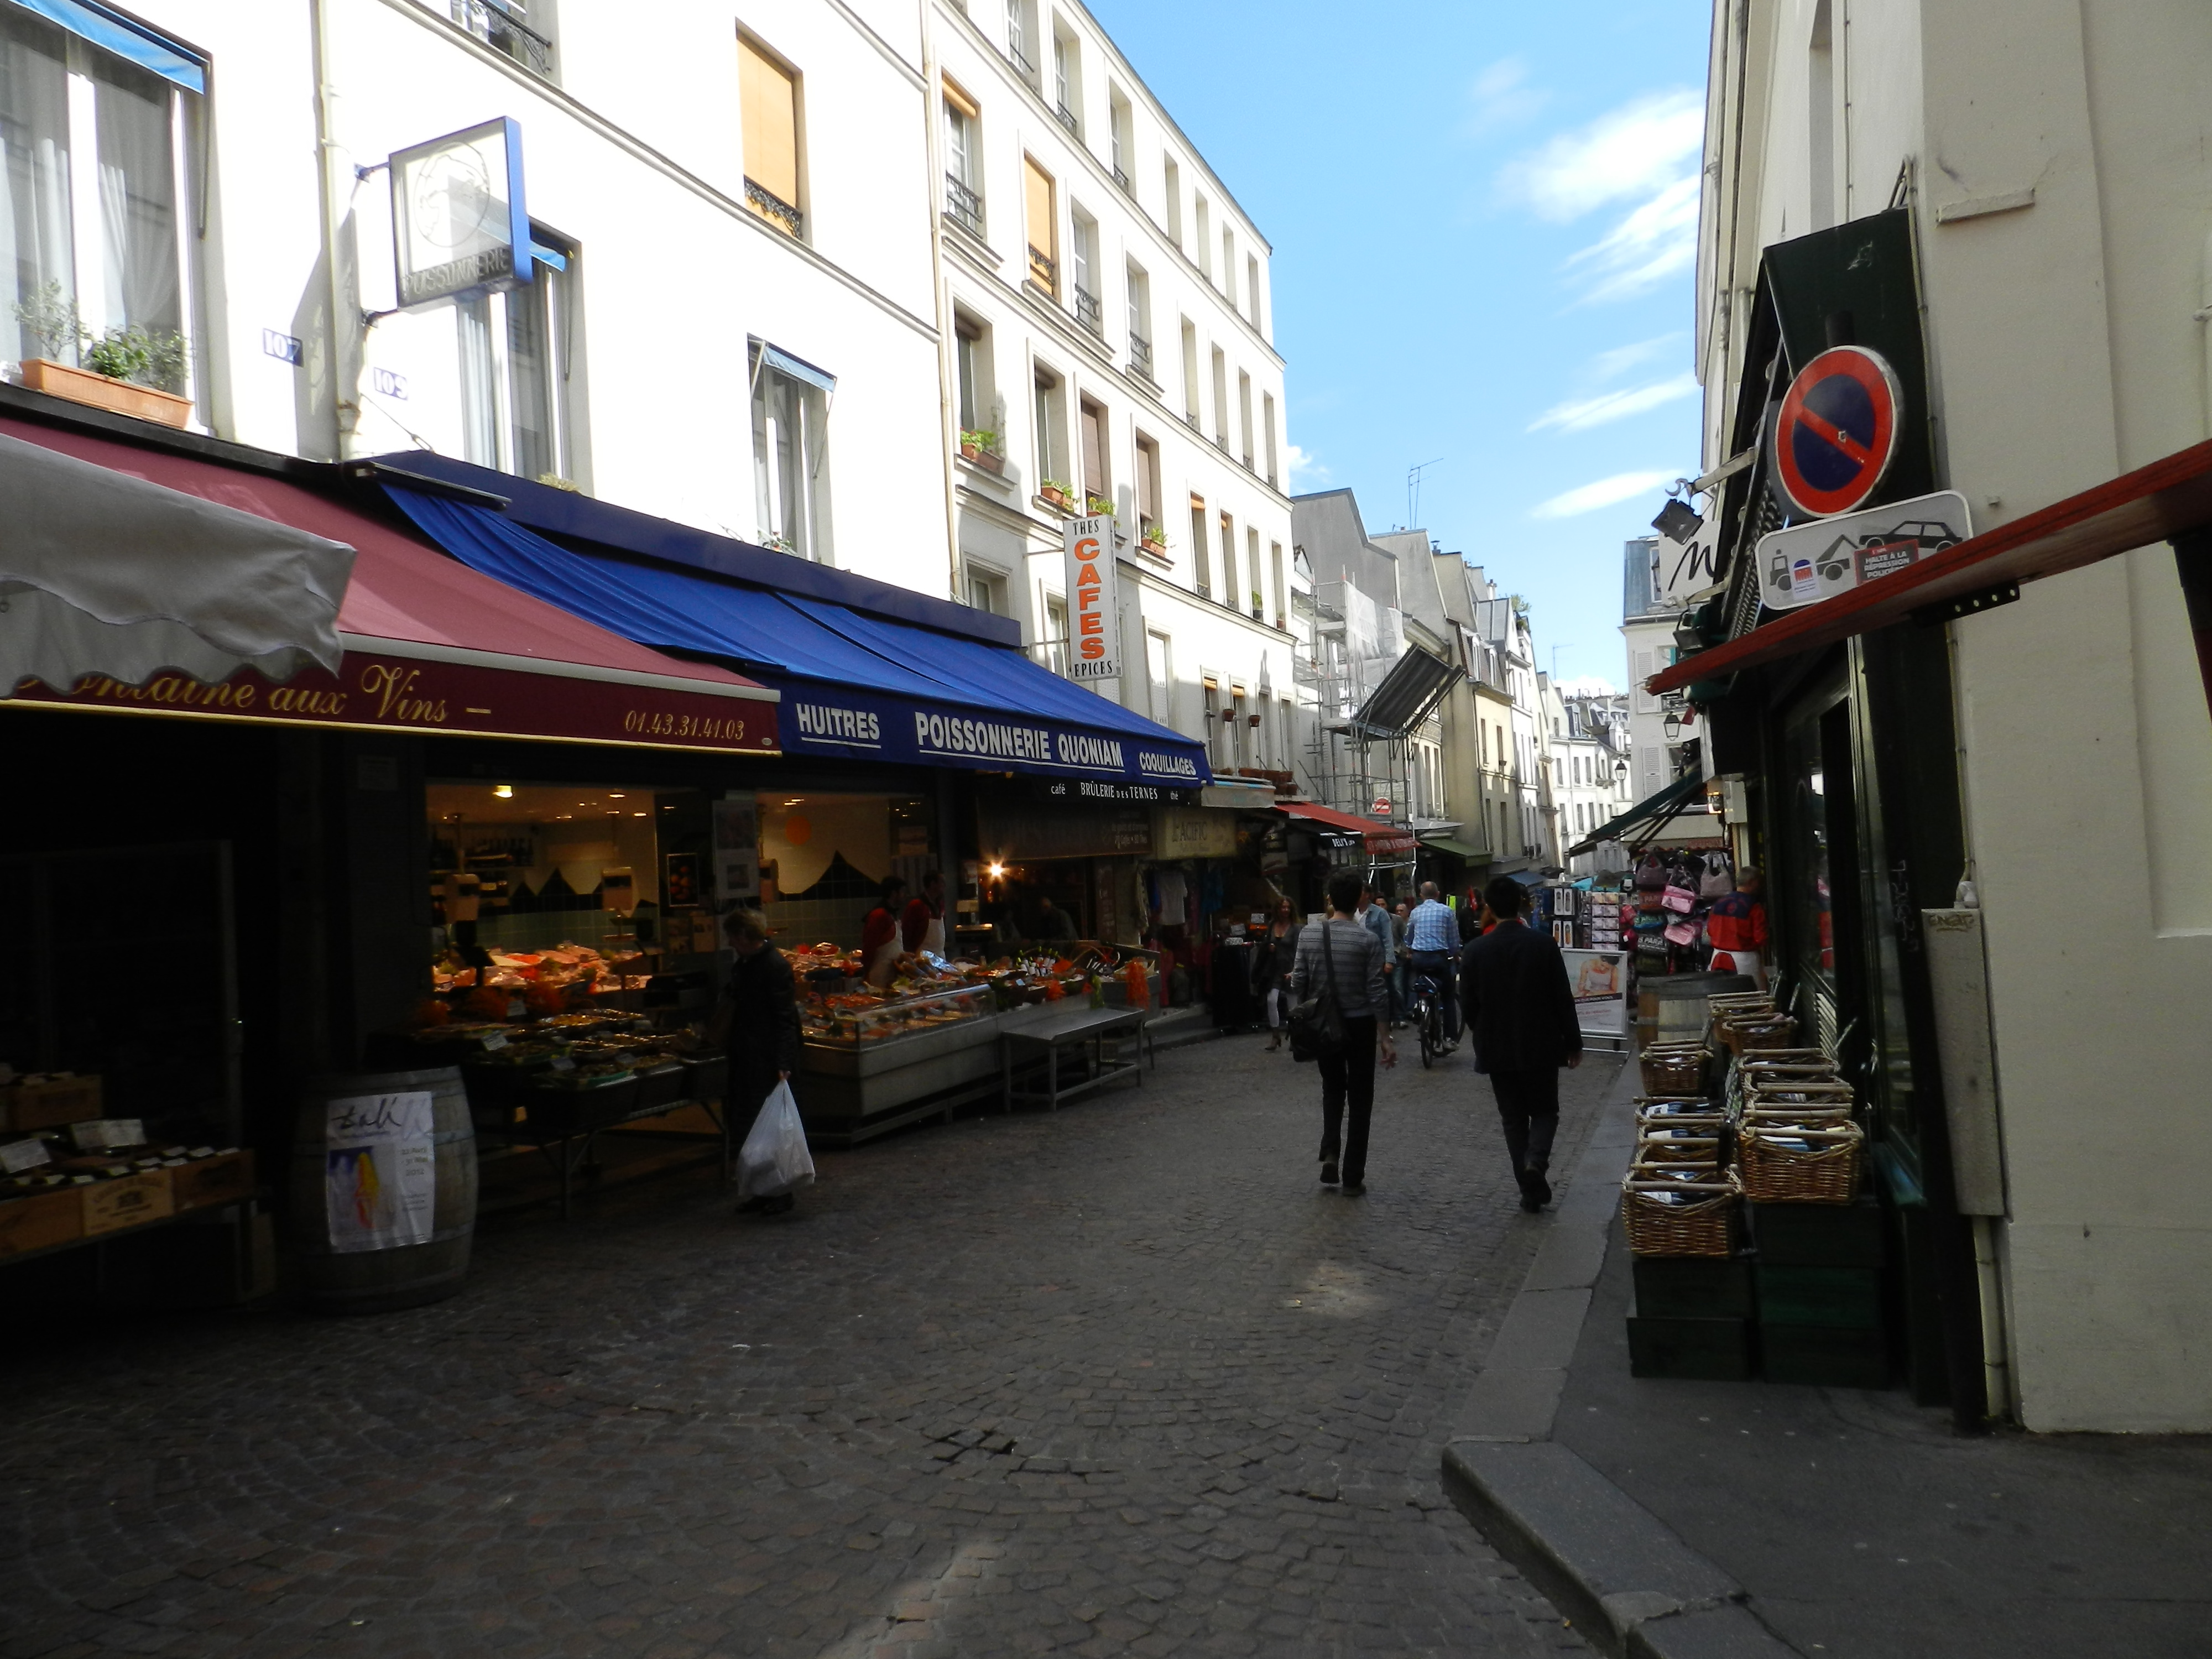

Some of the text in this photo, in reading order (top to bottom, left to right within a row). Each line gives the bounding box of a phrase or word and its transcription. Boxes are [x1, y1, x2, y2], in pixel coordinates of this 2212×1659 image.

[264, 330, 301, 362] 107
[376, 368, 408, 399] 109
[1073, 519, 1099, 536] THES
[1865, 555, 1888, 564] HALTE
[1074, 538, 1105, 660] CAFES
[1074, 660, 1113, 677] EPICES
[269, 687, 348, 715] aux
[360, 664, 448, 722] Vins
[625, 710, 744, 740] 01.43.31.41.03
[796, 703, 881, 740] HUITRES
[915, 711, 1124, 767] POISSONNERIE QUONIAM
[1139, 752, 1197, 775] COQUILLAGES
[1051, 783, 1066, 795] café
[1080, 780, 1115, 798] BRÛLERIE
[1129, 786, 1158, 800] TERNES
